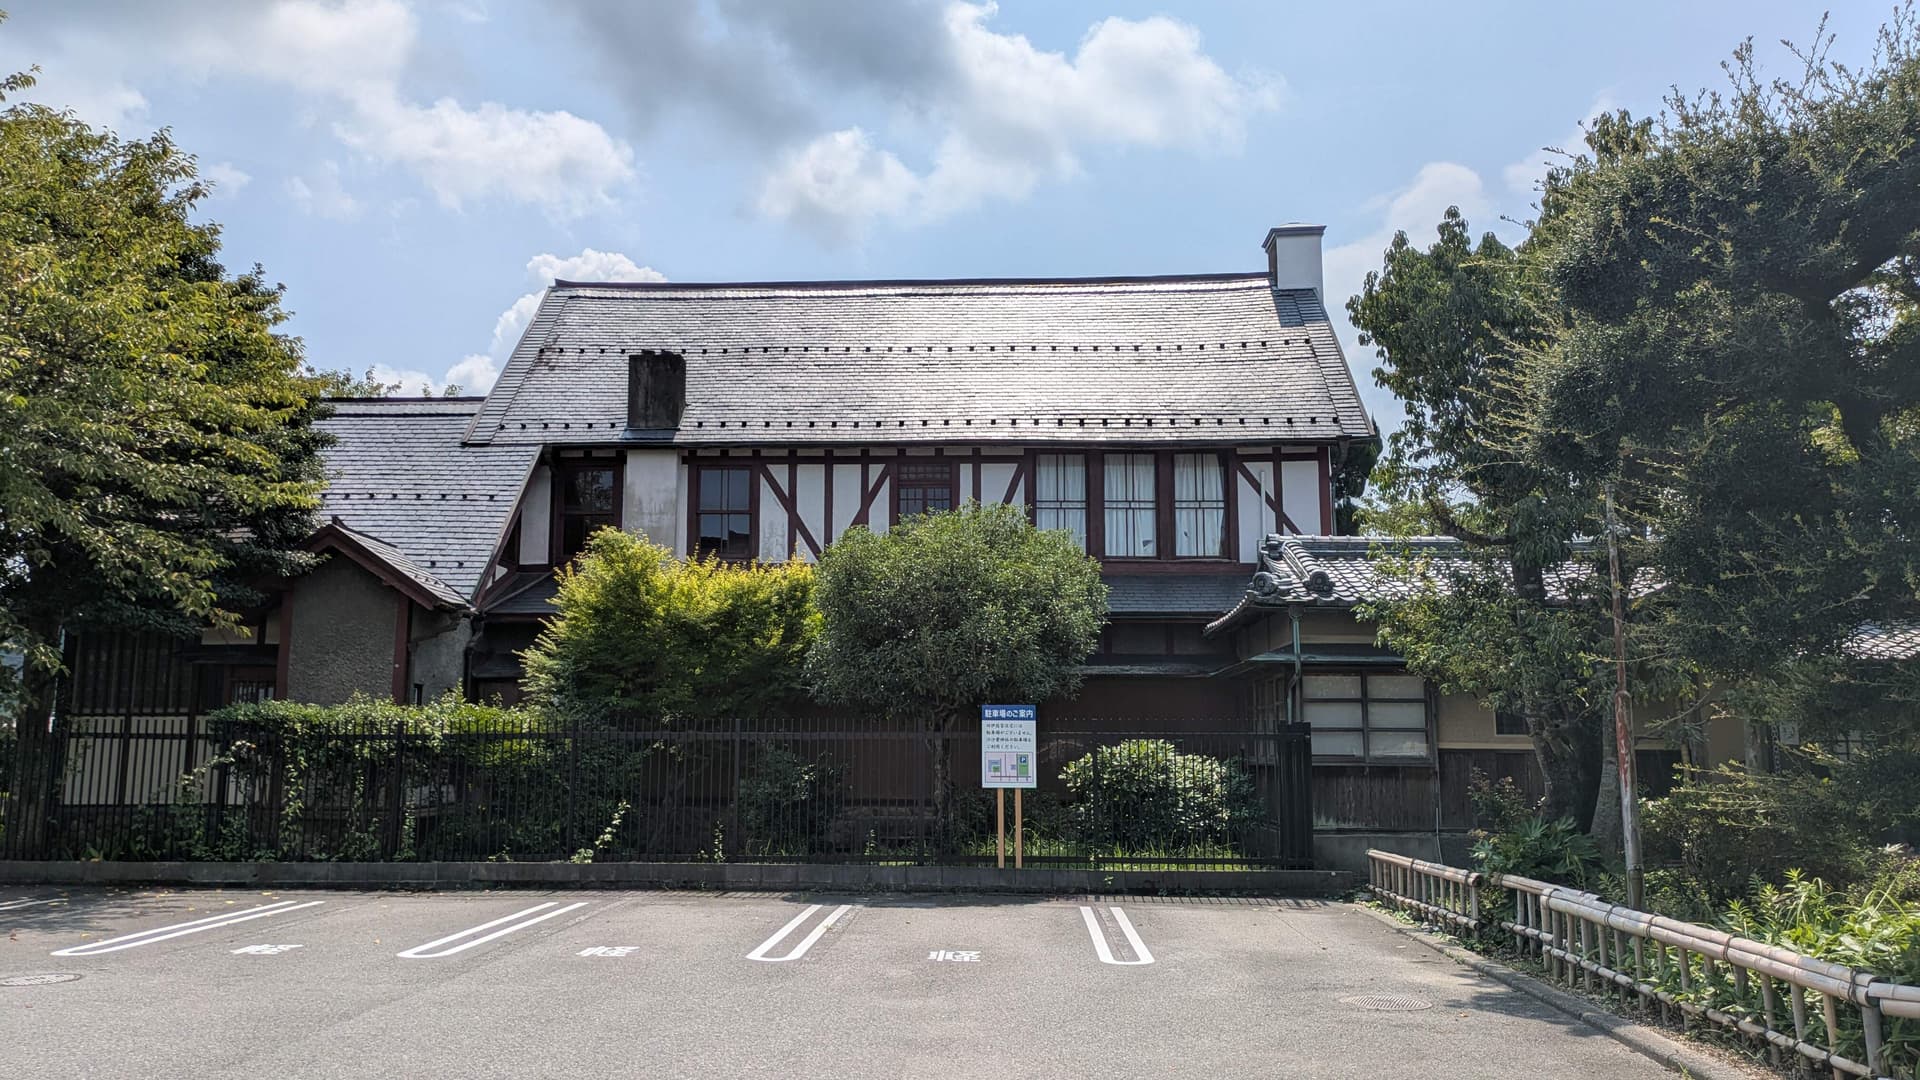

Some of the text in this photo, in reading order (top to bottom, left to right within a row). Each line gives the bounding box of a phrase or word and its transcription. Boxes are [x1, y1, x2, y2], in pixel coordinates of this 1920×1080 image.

[985, 709, 1033, 718] 駐車場のご案内
